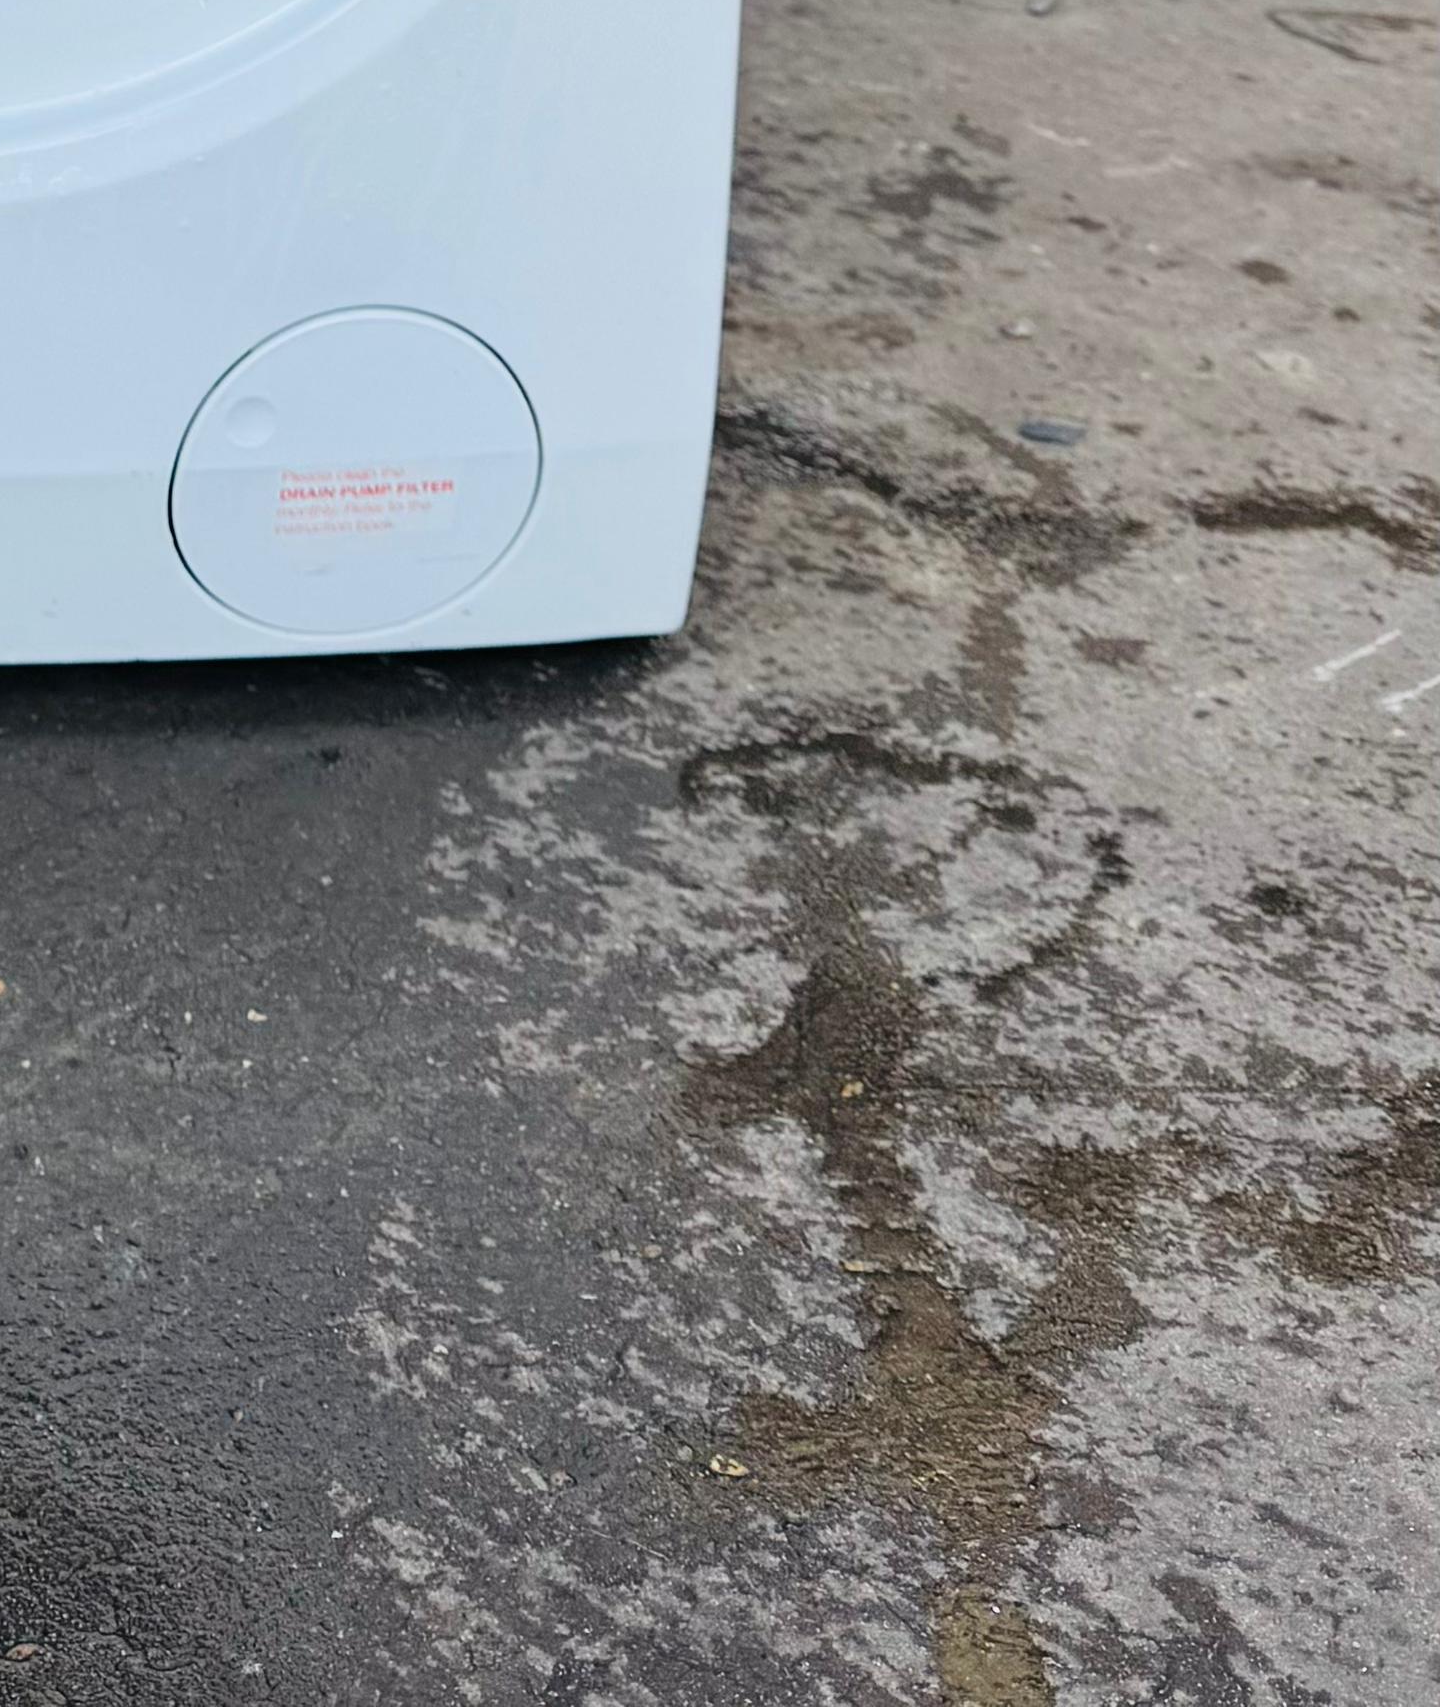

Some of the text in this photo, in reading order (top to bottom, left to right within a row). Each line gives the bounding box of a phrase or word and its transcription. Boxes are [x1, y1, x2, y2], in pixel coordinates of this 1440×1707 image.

[279, 479, 455, 502] DRAIN PUMP FILTER
